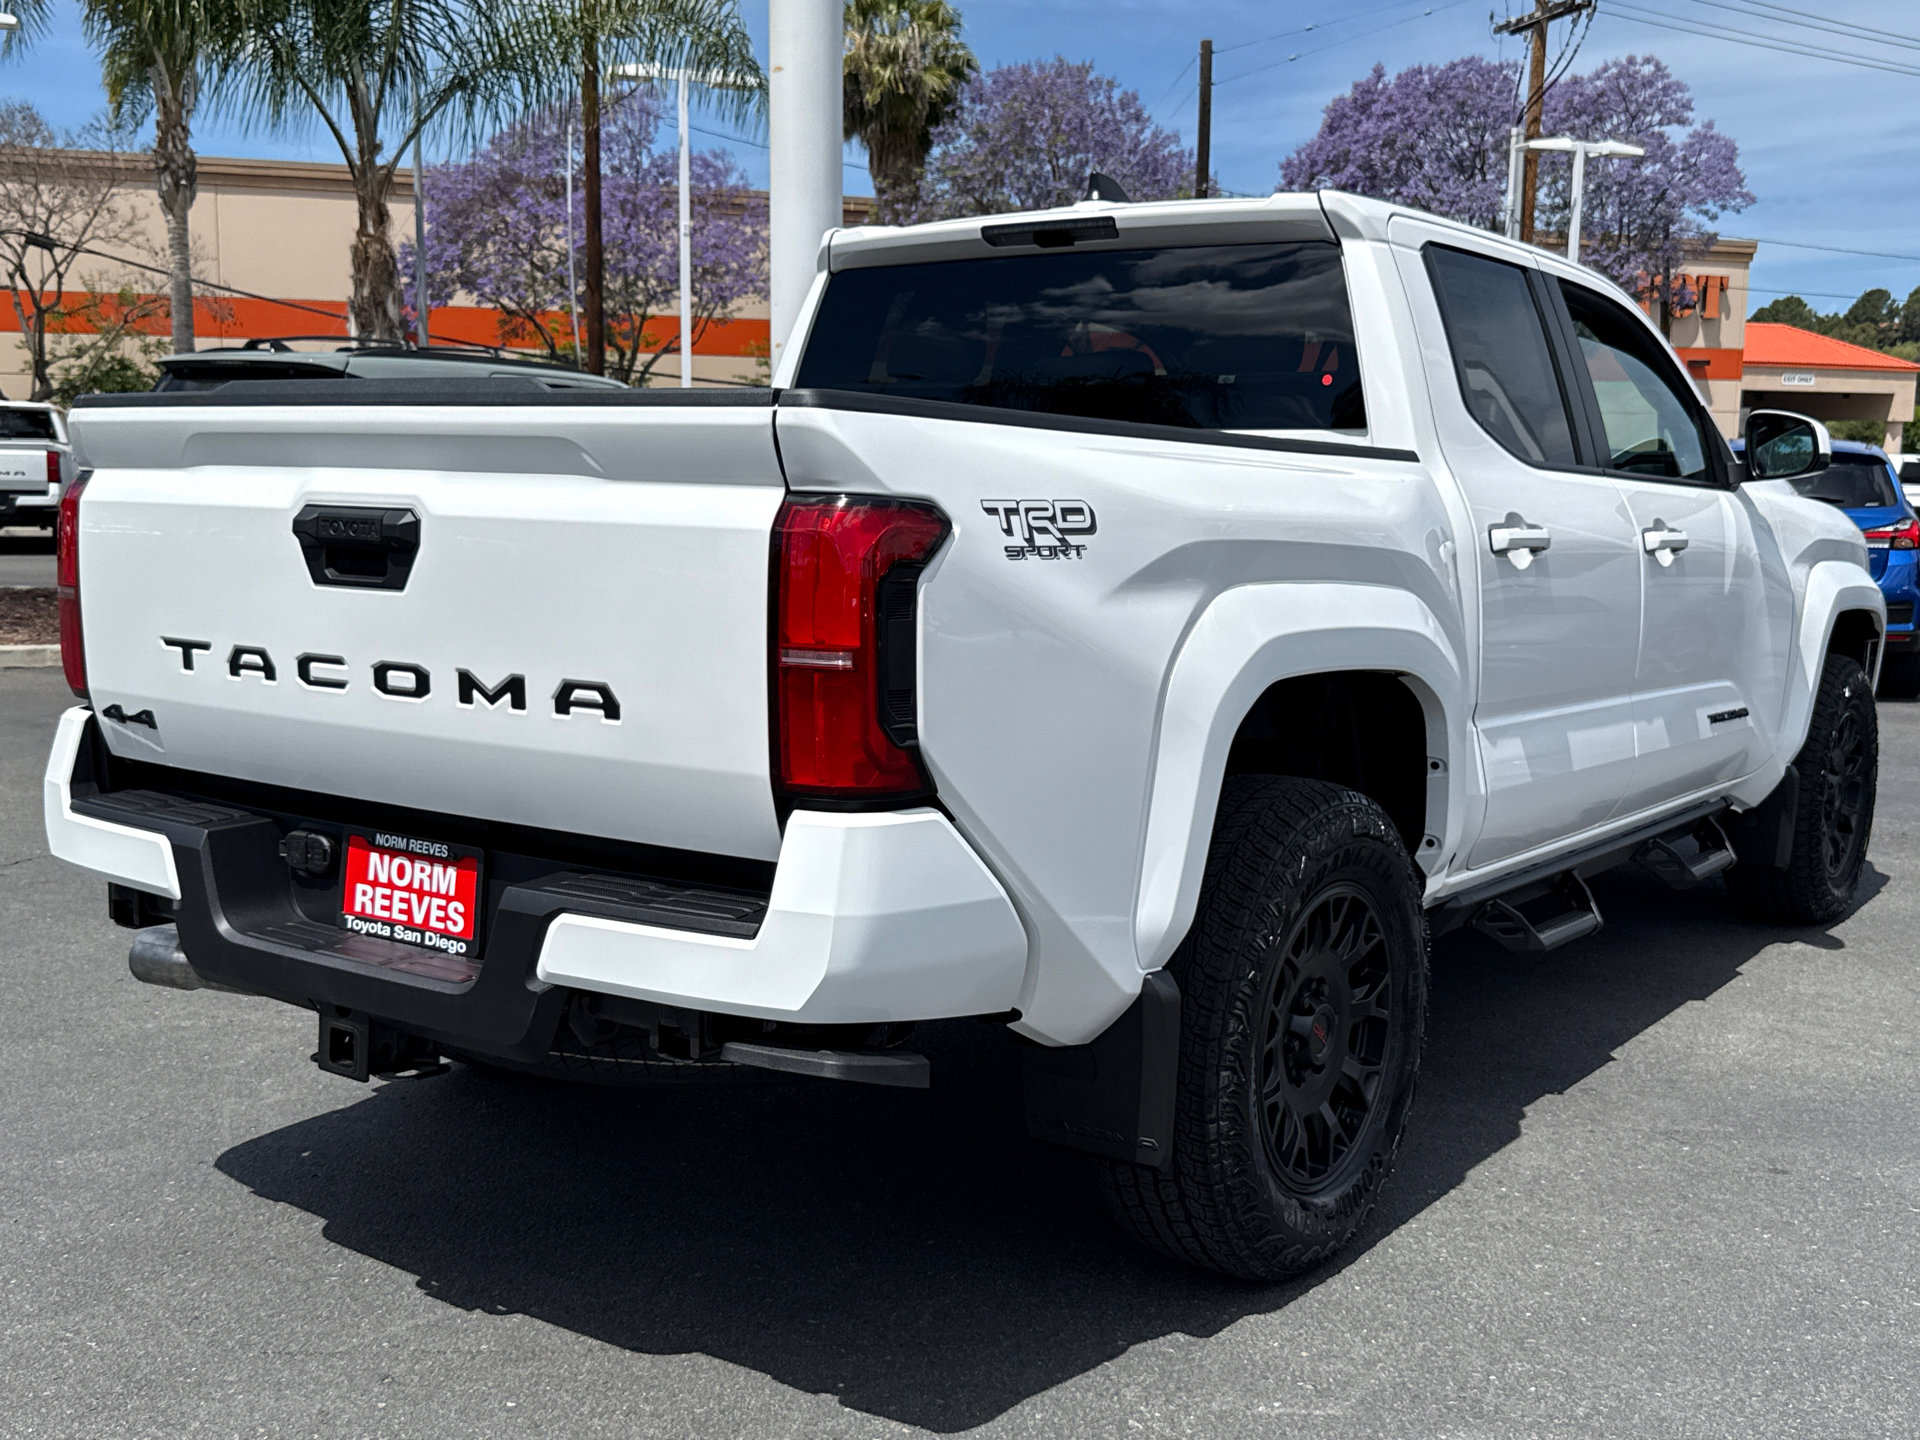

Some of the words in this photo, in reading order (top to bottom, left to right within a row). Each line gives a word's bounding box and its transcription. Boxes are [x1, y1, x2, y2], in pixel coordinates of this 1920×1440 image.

[1783, 375, 1796, 383] EXIT
[1797, 375, 1813, 384] ONLY
[321, 519, 379, 538] TOYOTA
[981, 499, 1097, 546] TRD
[1004, 545, 1087, 561] SPORT
[160, 635, 622, 721] TACOMA
[375, 833, 407, 850] NORM
[409, 839, 449, 858] REEVES
[367, 852, 457, 896] NORM
[354, 883, 465, 933] REEVES
[345, 915, 391, 936] Toyota
[394, 925, 421, 943] San
[424, 932, 467, 954] Diego
